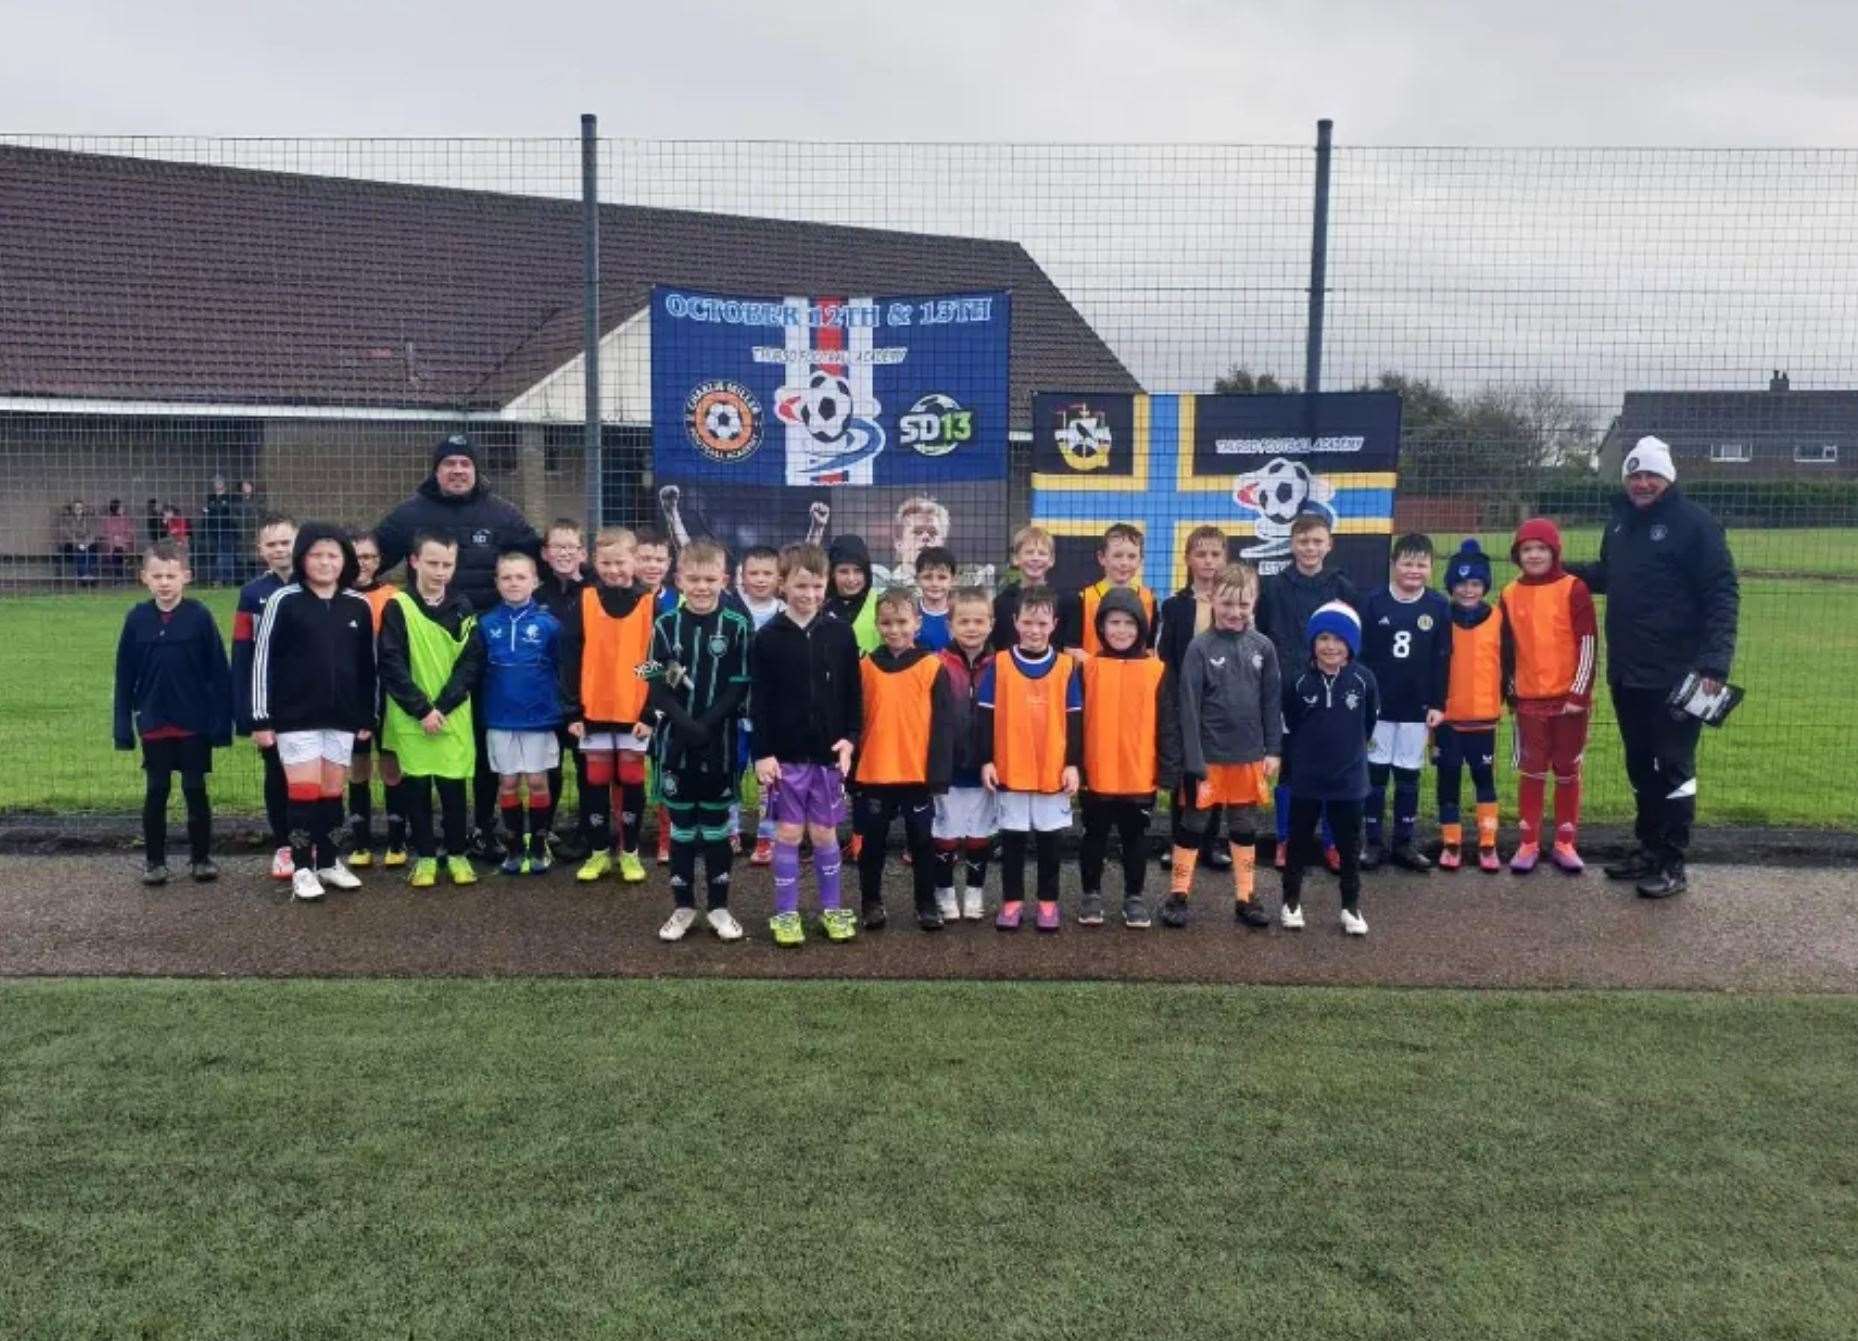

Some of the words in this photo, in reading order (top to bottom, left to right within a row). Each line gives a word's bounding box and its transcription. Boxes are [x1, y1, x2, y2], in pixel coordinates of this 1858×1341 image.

[665, 294, 799, 326] OCTOBER
[807, 303, 880, 327] 12TH
[887, 303, 912, 326] &
[920, 297, 993, 325] 13TH
[899, 411, 972, 444] SD13
[1393, 630, 1411, 658] 8
